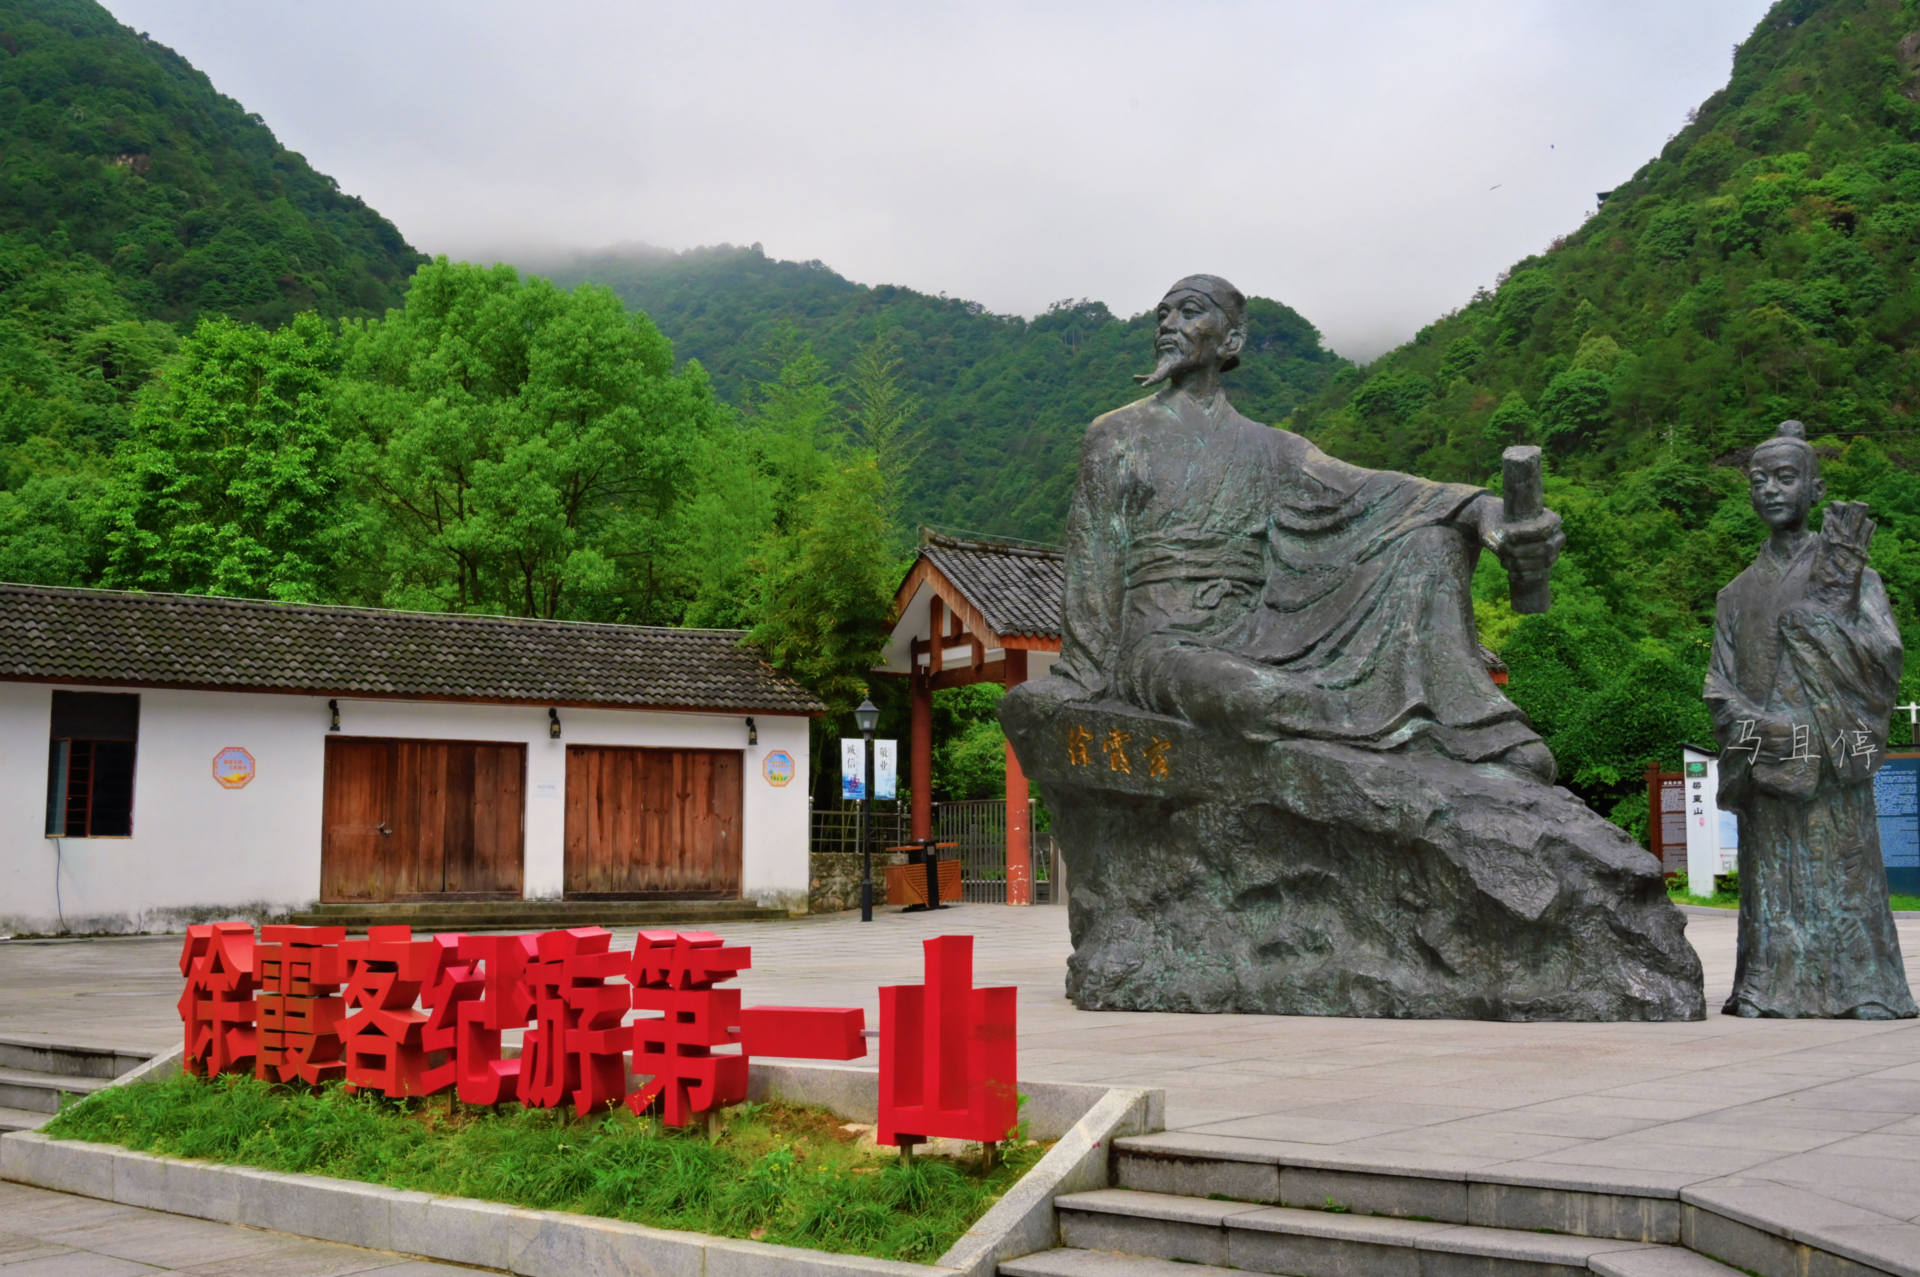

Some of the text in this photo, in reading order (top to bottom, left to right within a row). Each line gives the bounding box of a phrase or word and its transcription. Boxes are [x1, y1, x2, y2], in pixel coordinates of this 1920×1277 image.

[1067, 725, 1172, 781] 徐霞客
[178, 921, 1018, 1147] 徐霞客纪游第一山
